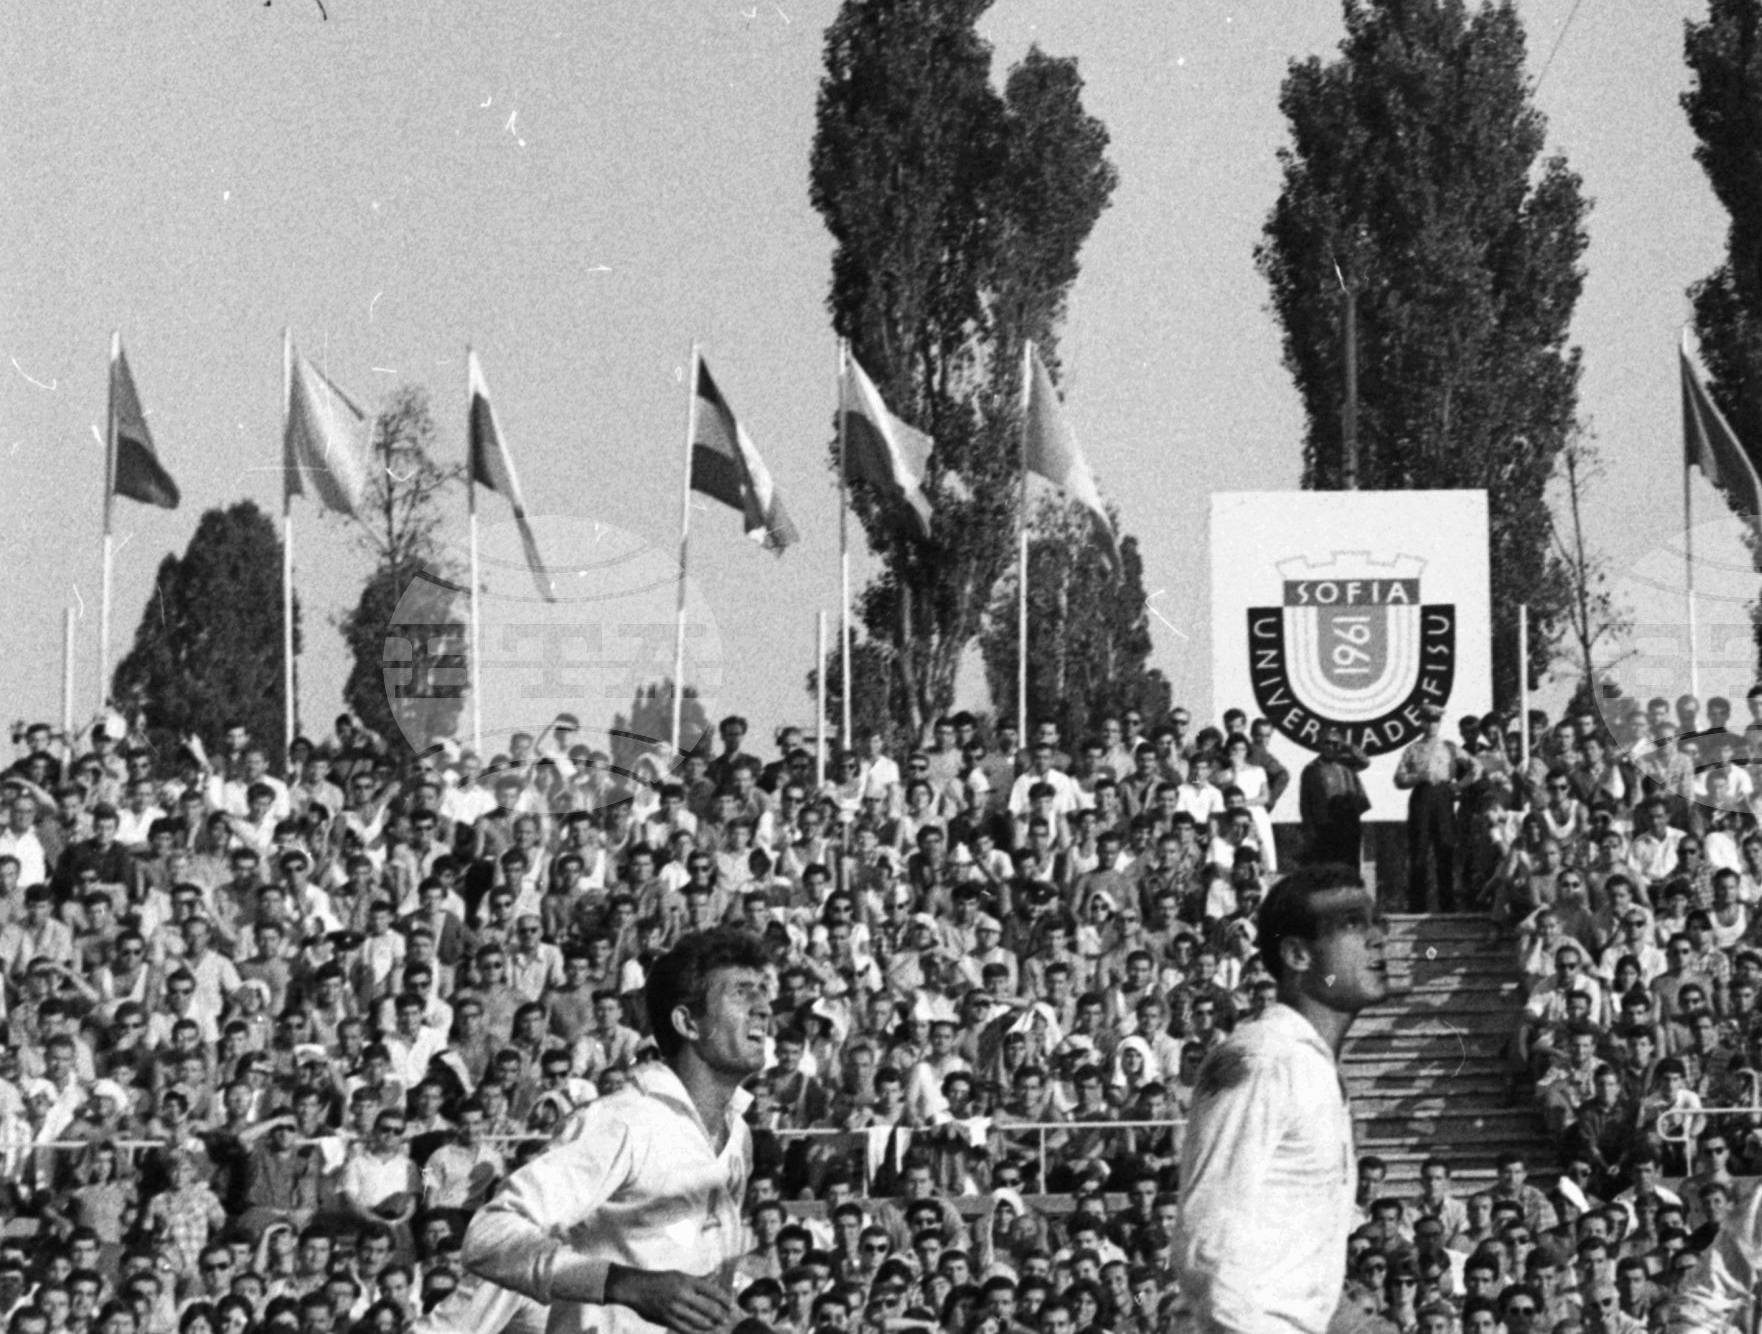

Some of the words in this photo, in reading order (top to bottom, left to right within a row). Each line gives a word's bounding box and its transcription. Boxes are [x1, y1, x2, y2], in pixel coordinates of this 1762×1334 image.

[1298, 582, 1409, 604] SOFIA
[1333, 617, 1371, 675] 1961
[1253, 618, 1421, 750] UNIVERIADE
[1422, 615, 1451, 698] FISU
